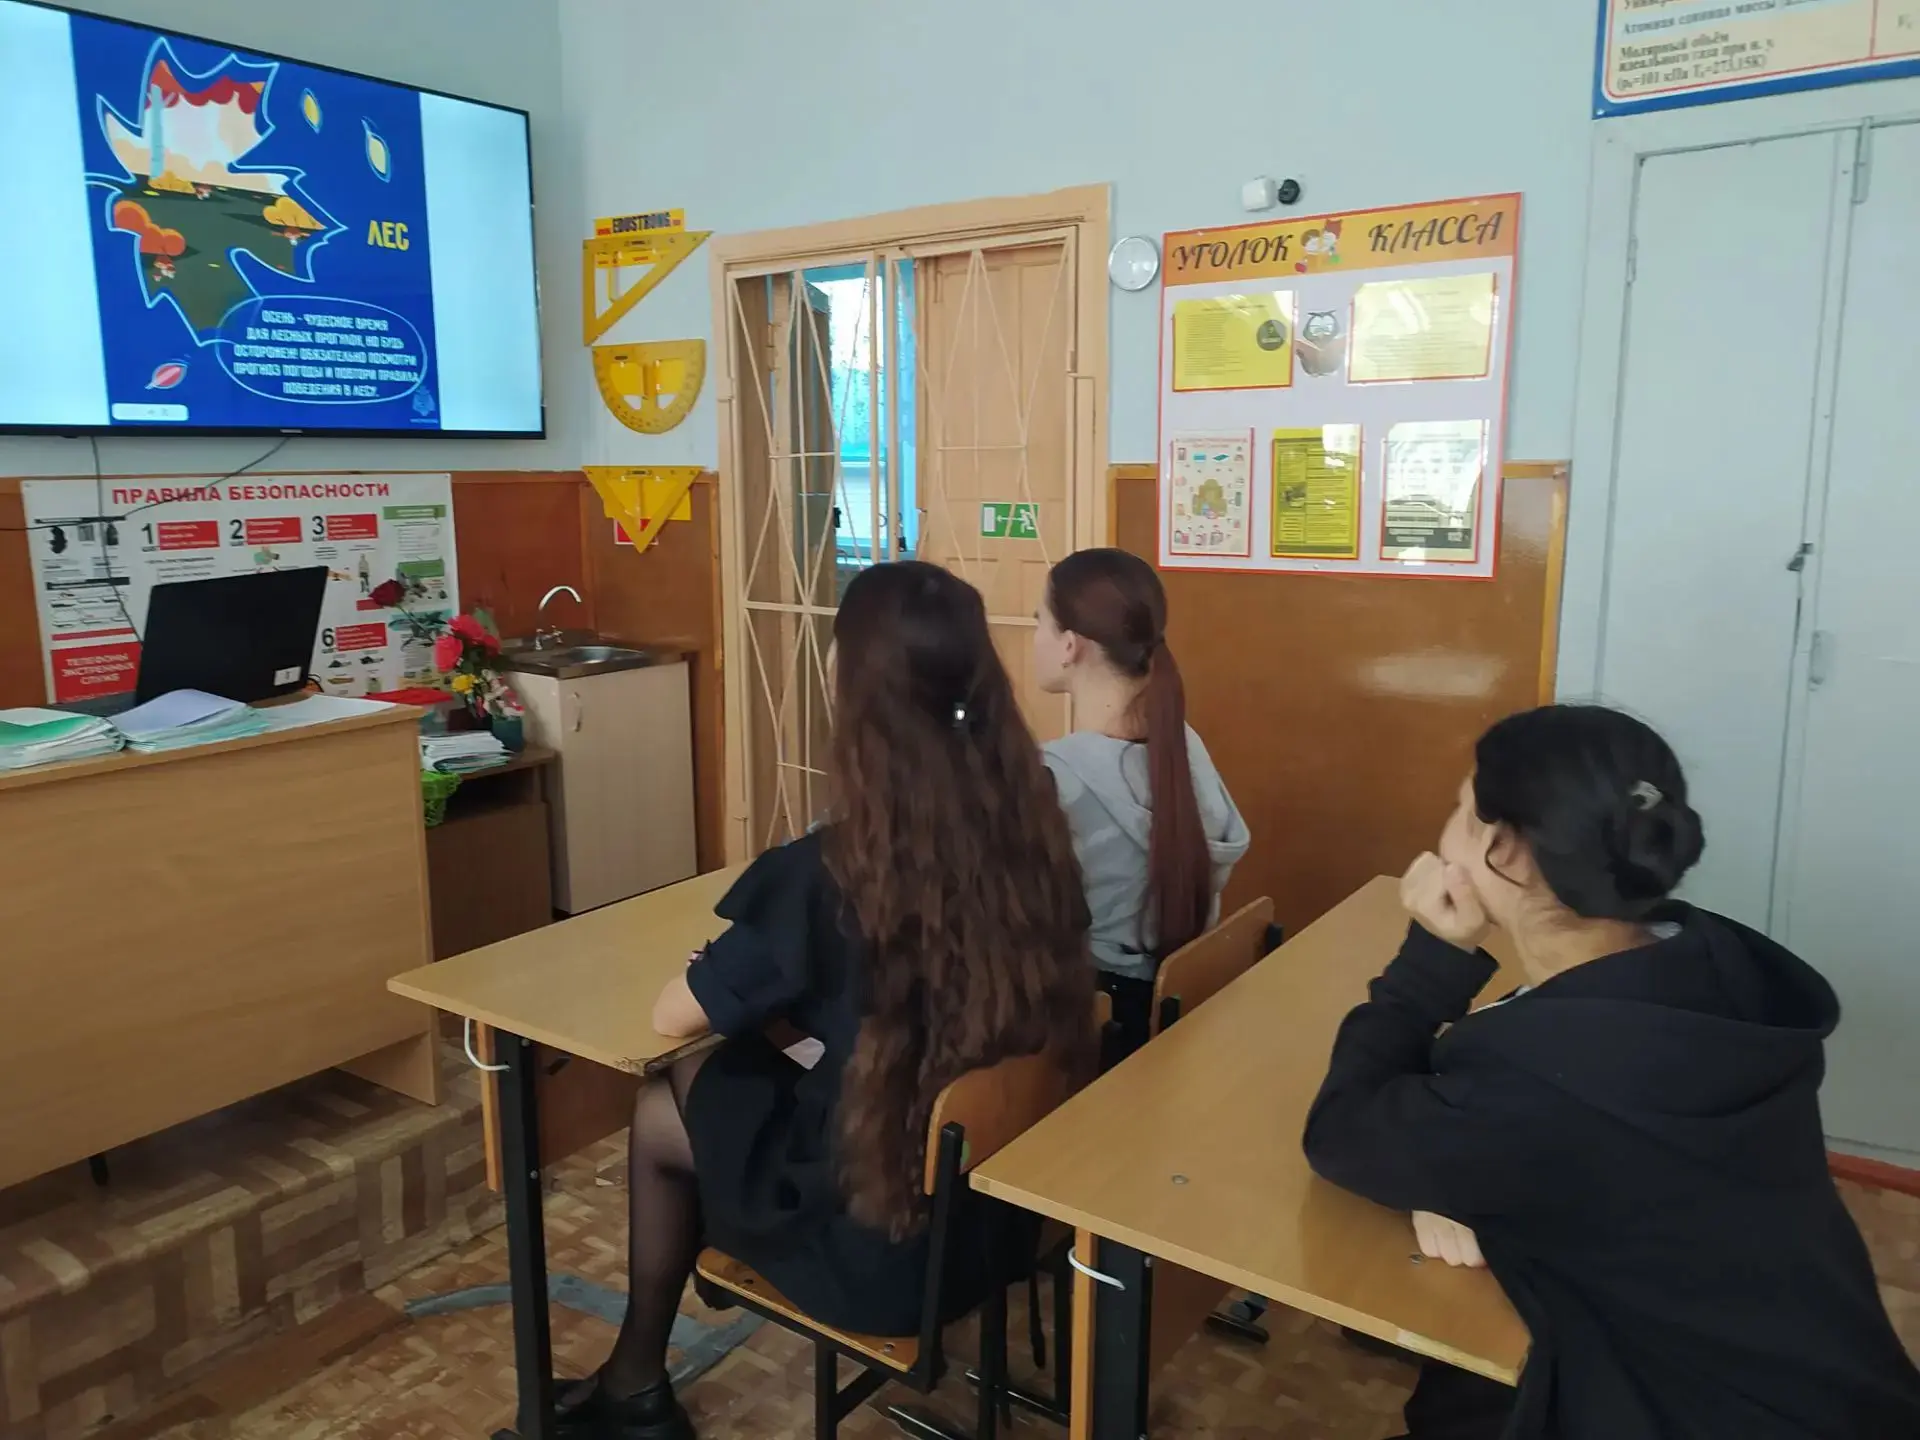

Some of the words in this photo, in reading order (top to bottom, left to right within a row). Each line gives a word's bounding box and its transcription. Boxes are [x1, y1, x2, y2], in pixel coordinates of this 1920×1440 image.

[613, 211, 671, 233] EDUSTRONG
[367, 219, 410, 251] ЛЕС
[1172, 234, 1294, 271] УГОЛОК
[1368, 211, 1504, 254] КЛАССА
[261, 310, 296, 325] ОСЕНЬ
[303, 313, 354, 329] ЧУДЕСНОЕ
[355, 317, 388, 331] ВРЕМЯ
[246, 327, 270, 341] ДЛЯ
[271, 329, 314, 343] ЛЕСНЫХ
[299, 348, 367, 364] ОБЯЗАТЕЛЬНО
[368, 352, 417, 367] ПОСМОТРИ
[233, 362, 281, 377] ПРОГНОЗ
[282, 382, 343, 396] ПОВЕДЕНИЯ
[112, 487, 221, 505] ПРАВИЛА
[228, 483, 389, 501] БЕЗОПАСНОСТИ
[141, 522, 153, 545] 1
[229, 519, 244, 540] 2
[312, 515, 325, 536] 3
[321, 627, 335, 648] 6
[61, 662, 136, 678] ЭКСТРЕННЫХ
[65, 653, 129, 667] ТЕЛЕФОНЫ
